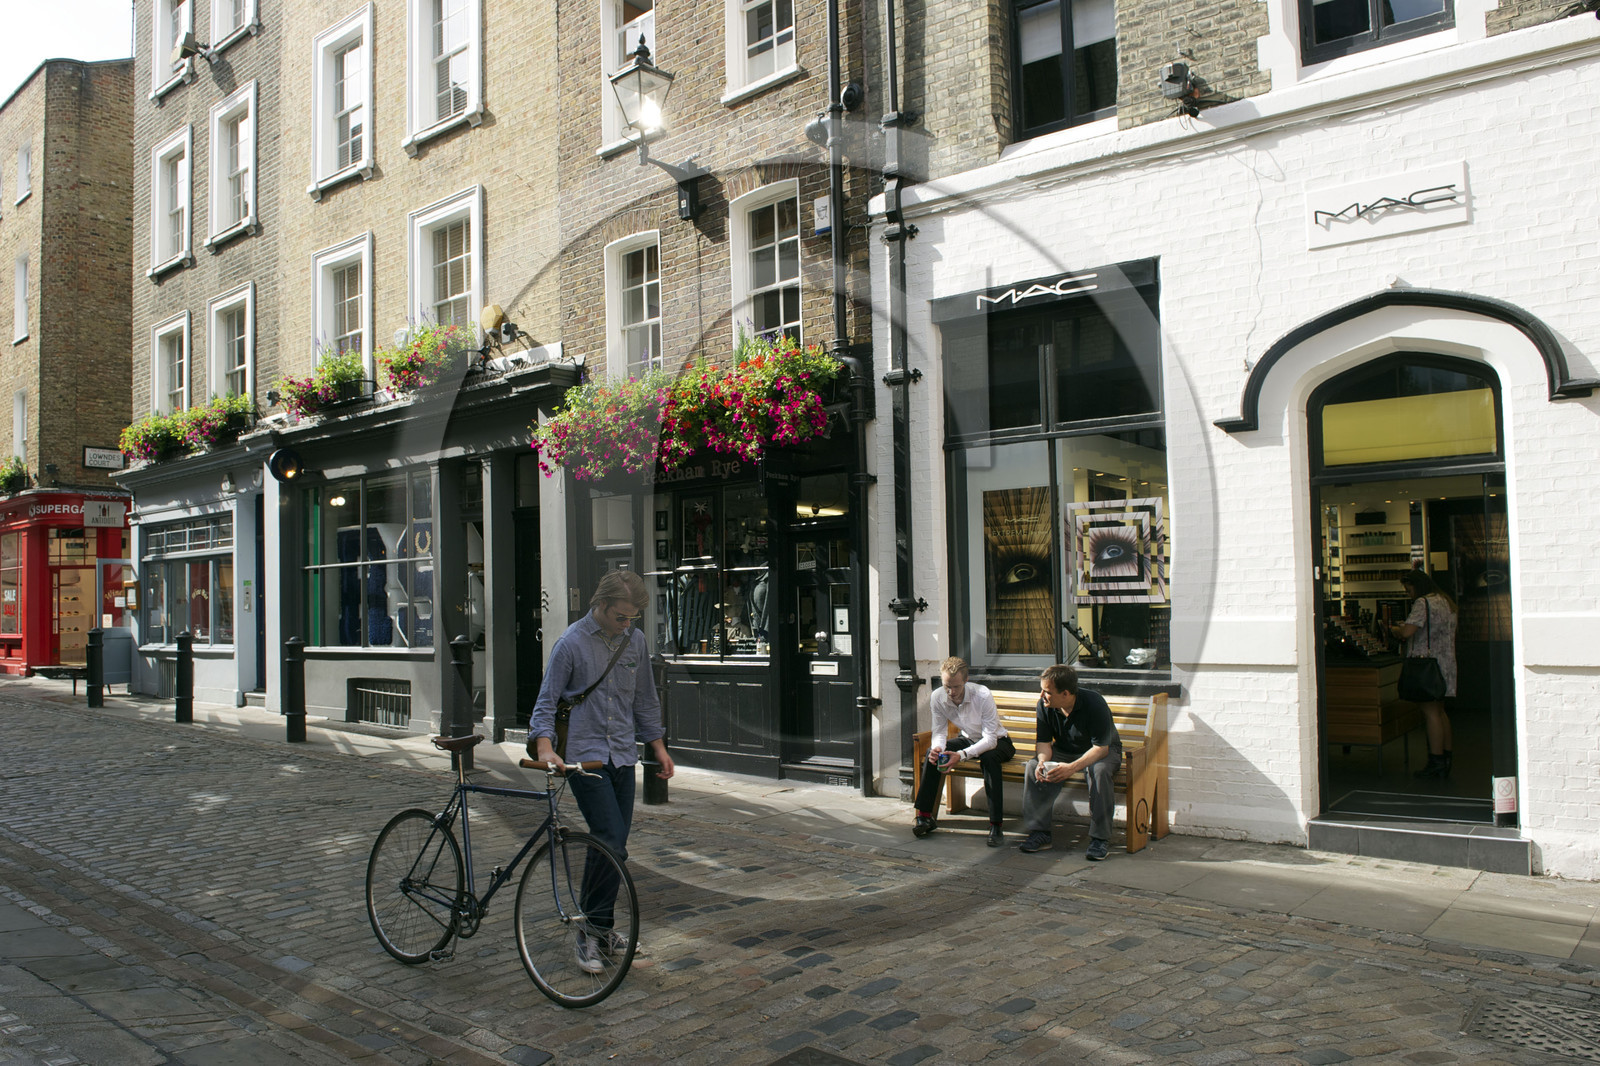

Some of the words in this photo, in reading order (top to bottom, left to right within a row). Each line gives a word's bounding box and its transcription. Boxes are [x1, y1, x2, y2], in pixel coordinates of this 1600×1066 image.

[88, 453, 121, 462] LOWNDES
[88, 459, 111, 467] COURT
[641, 464, 705, 486] Peckham
[711, 459, 742, 479] Rye
[4, 589, 16, 602] SALE
[4, 604, 16, 616] SALE
